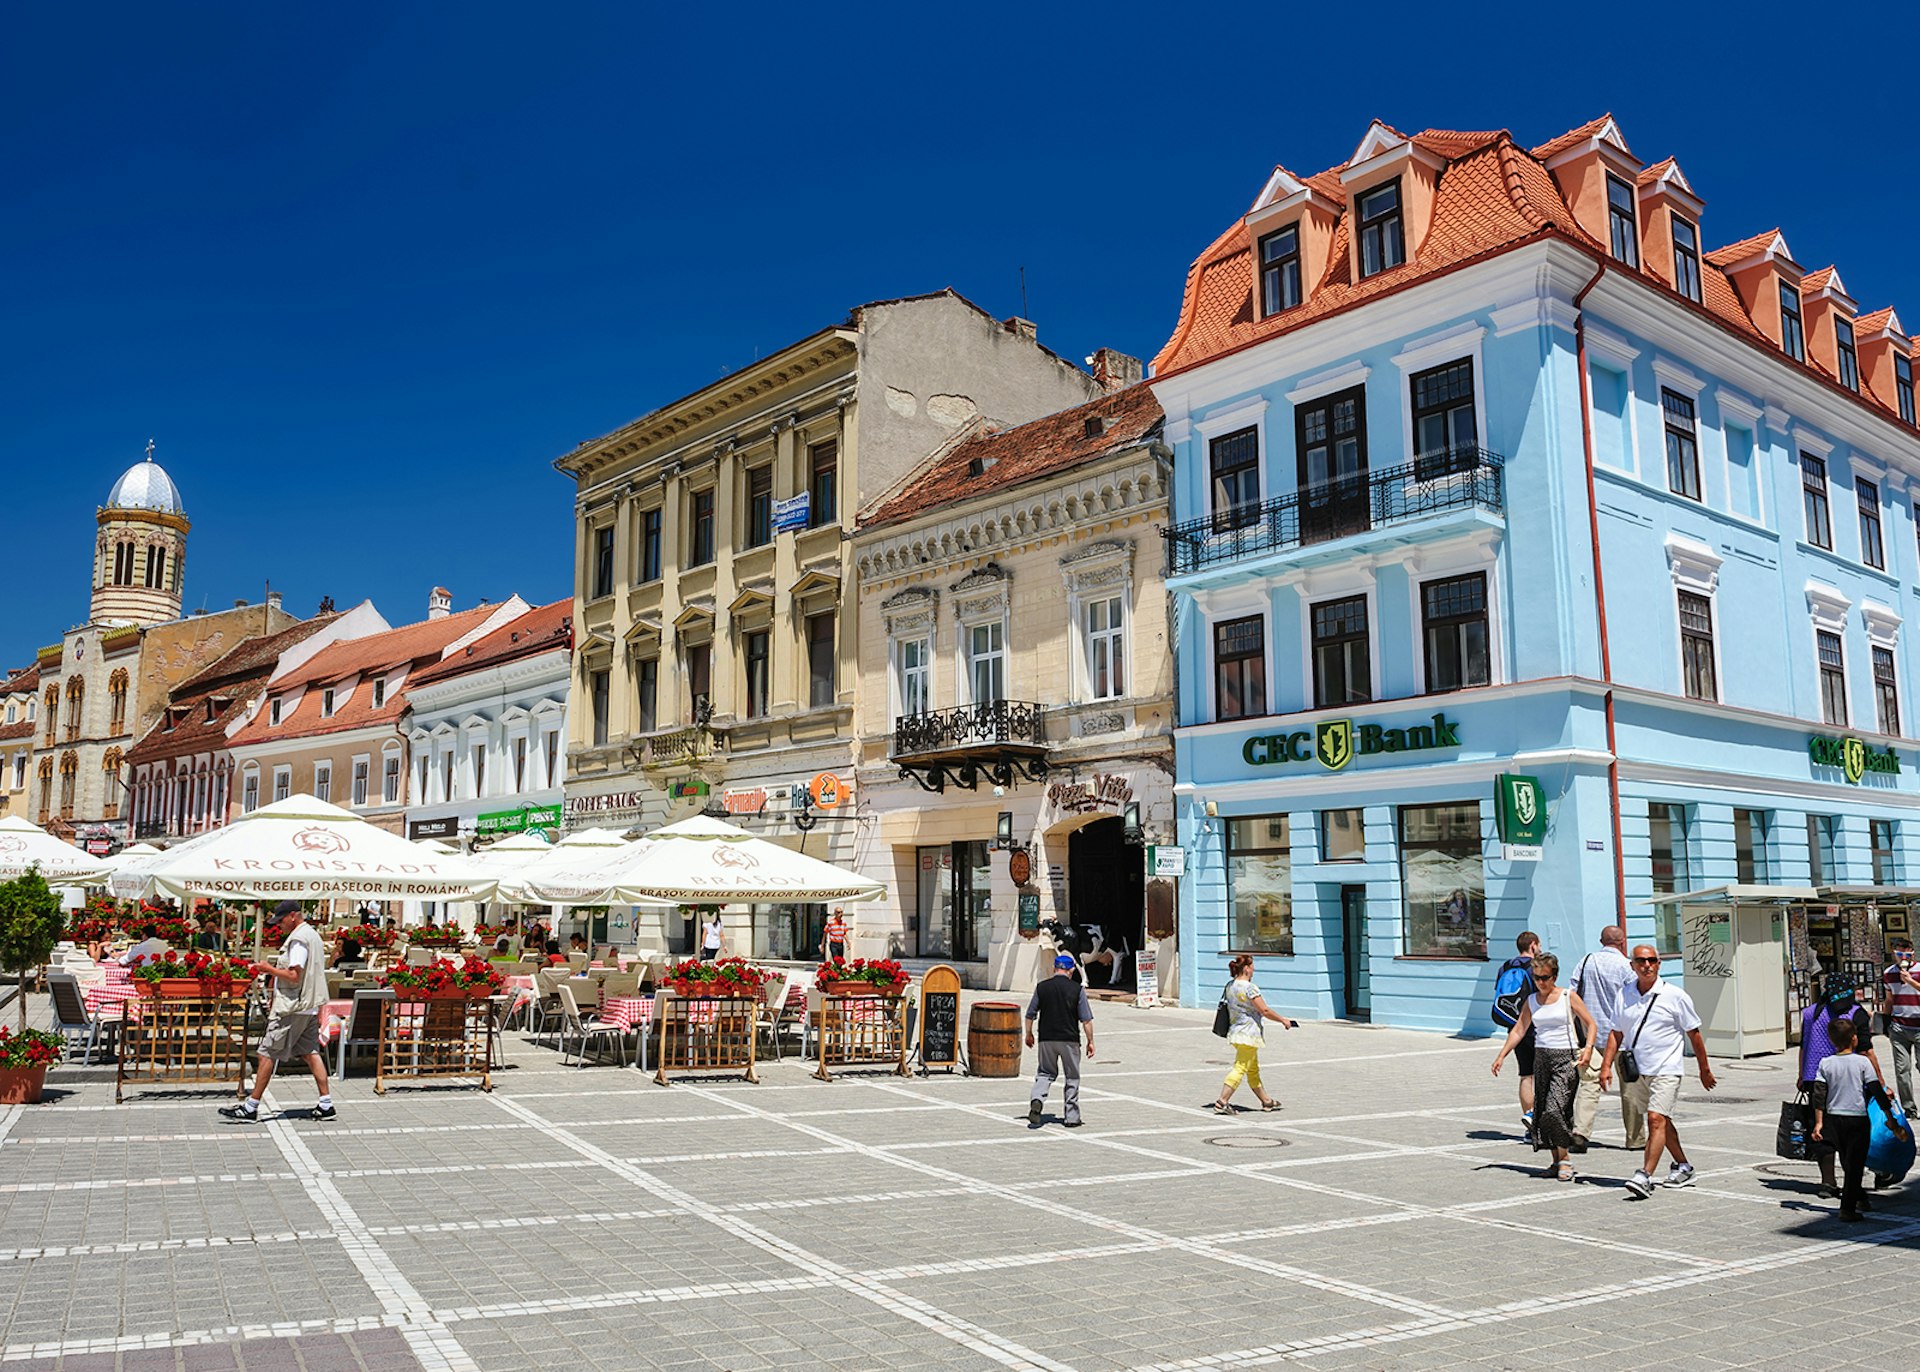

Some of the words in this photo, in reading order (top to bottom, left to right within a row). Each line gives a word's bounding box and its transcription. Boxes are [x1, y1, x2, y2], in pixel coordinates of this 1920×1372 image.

[1242, 731, 1311, 766] CEC
[1357, 712, 1462, 755] Bank
[1809, 735, 1845, 767] CEC
[1863, 745, 1902, 774] Bank
[723, 787, 767, 813] Farmaciile
[1513, 849, 1537, 857] BANCOMAT
[214, 858, 438, 874] KRONSTADT
[253, 880, 304, 892] REGELE
[310, 880, 382, 894] ORAȘELOR
[388, 880, 403, 893] ÎN
[692, 890, 734, 898] REGELE
[736, 890, 792, 899] ORAȘELOR
[796, 889, 807, 898] ÎN
